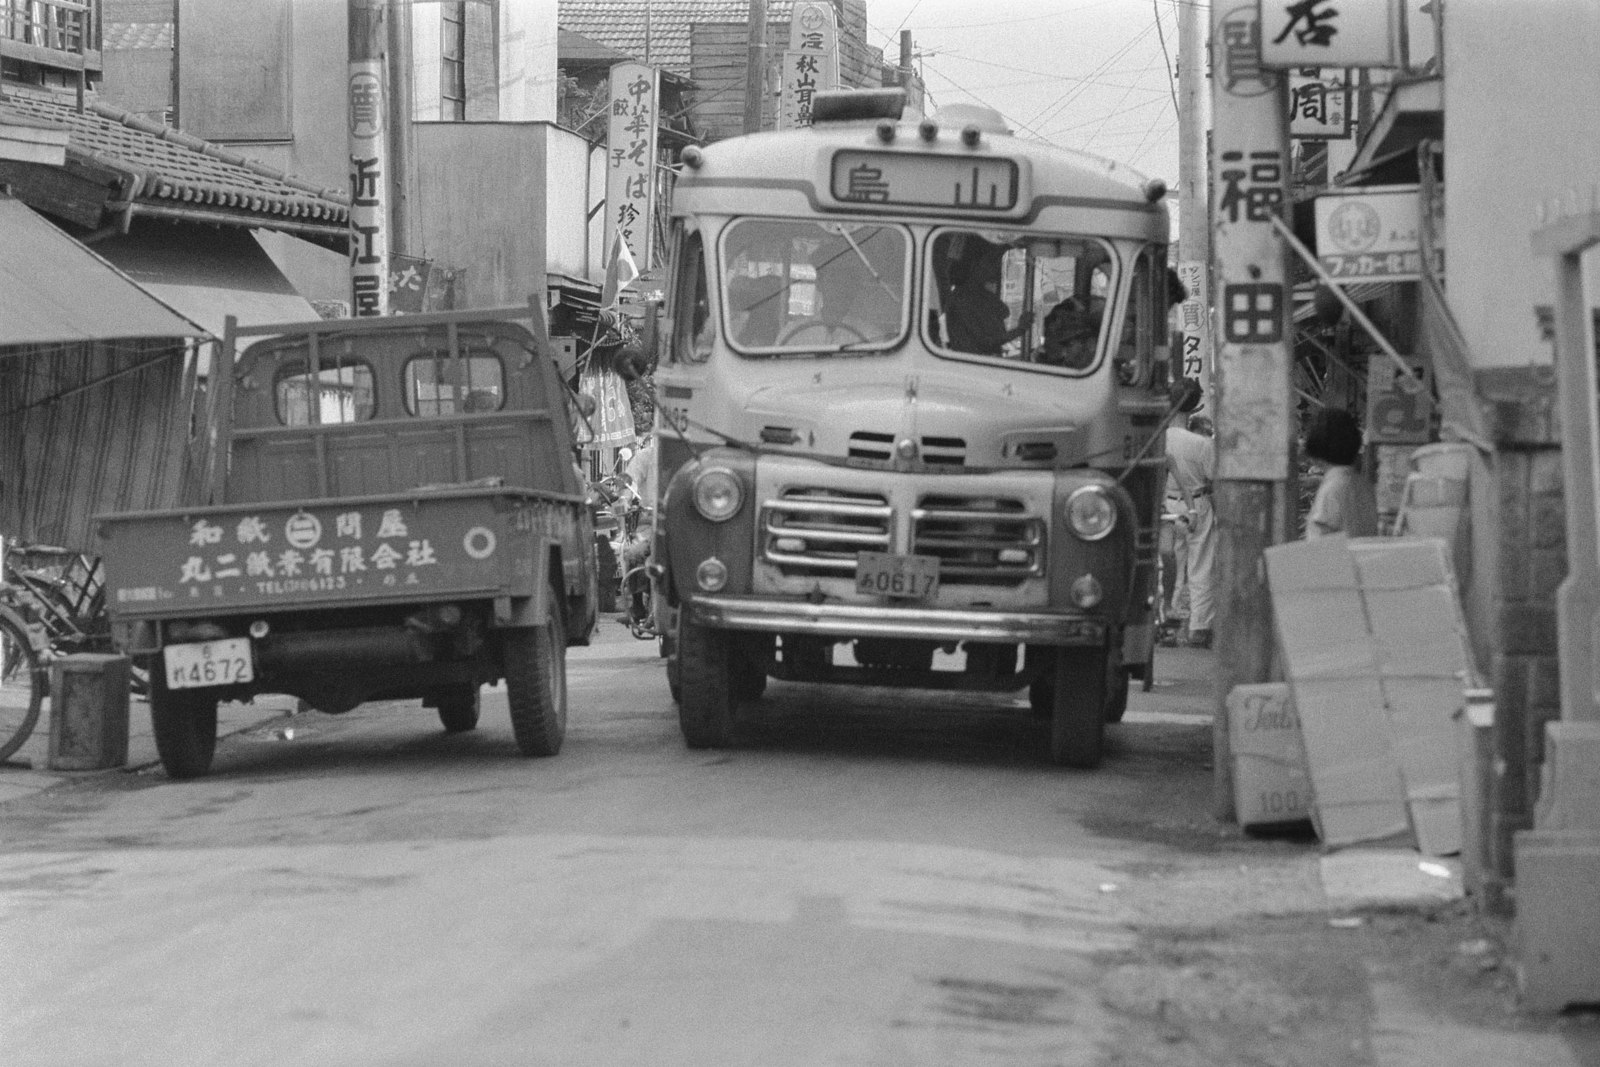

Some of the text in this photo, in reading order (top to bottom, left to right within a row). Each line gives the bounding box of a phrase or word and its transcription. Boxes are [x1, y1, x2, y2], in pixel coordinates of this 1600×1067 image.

[611, 98, 629, 169] 餃子
[624, 74, 652, 199] 中華そば
[349, 154, 382, 316] 近江屋
